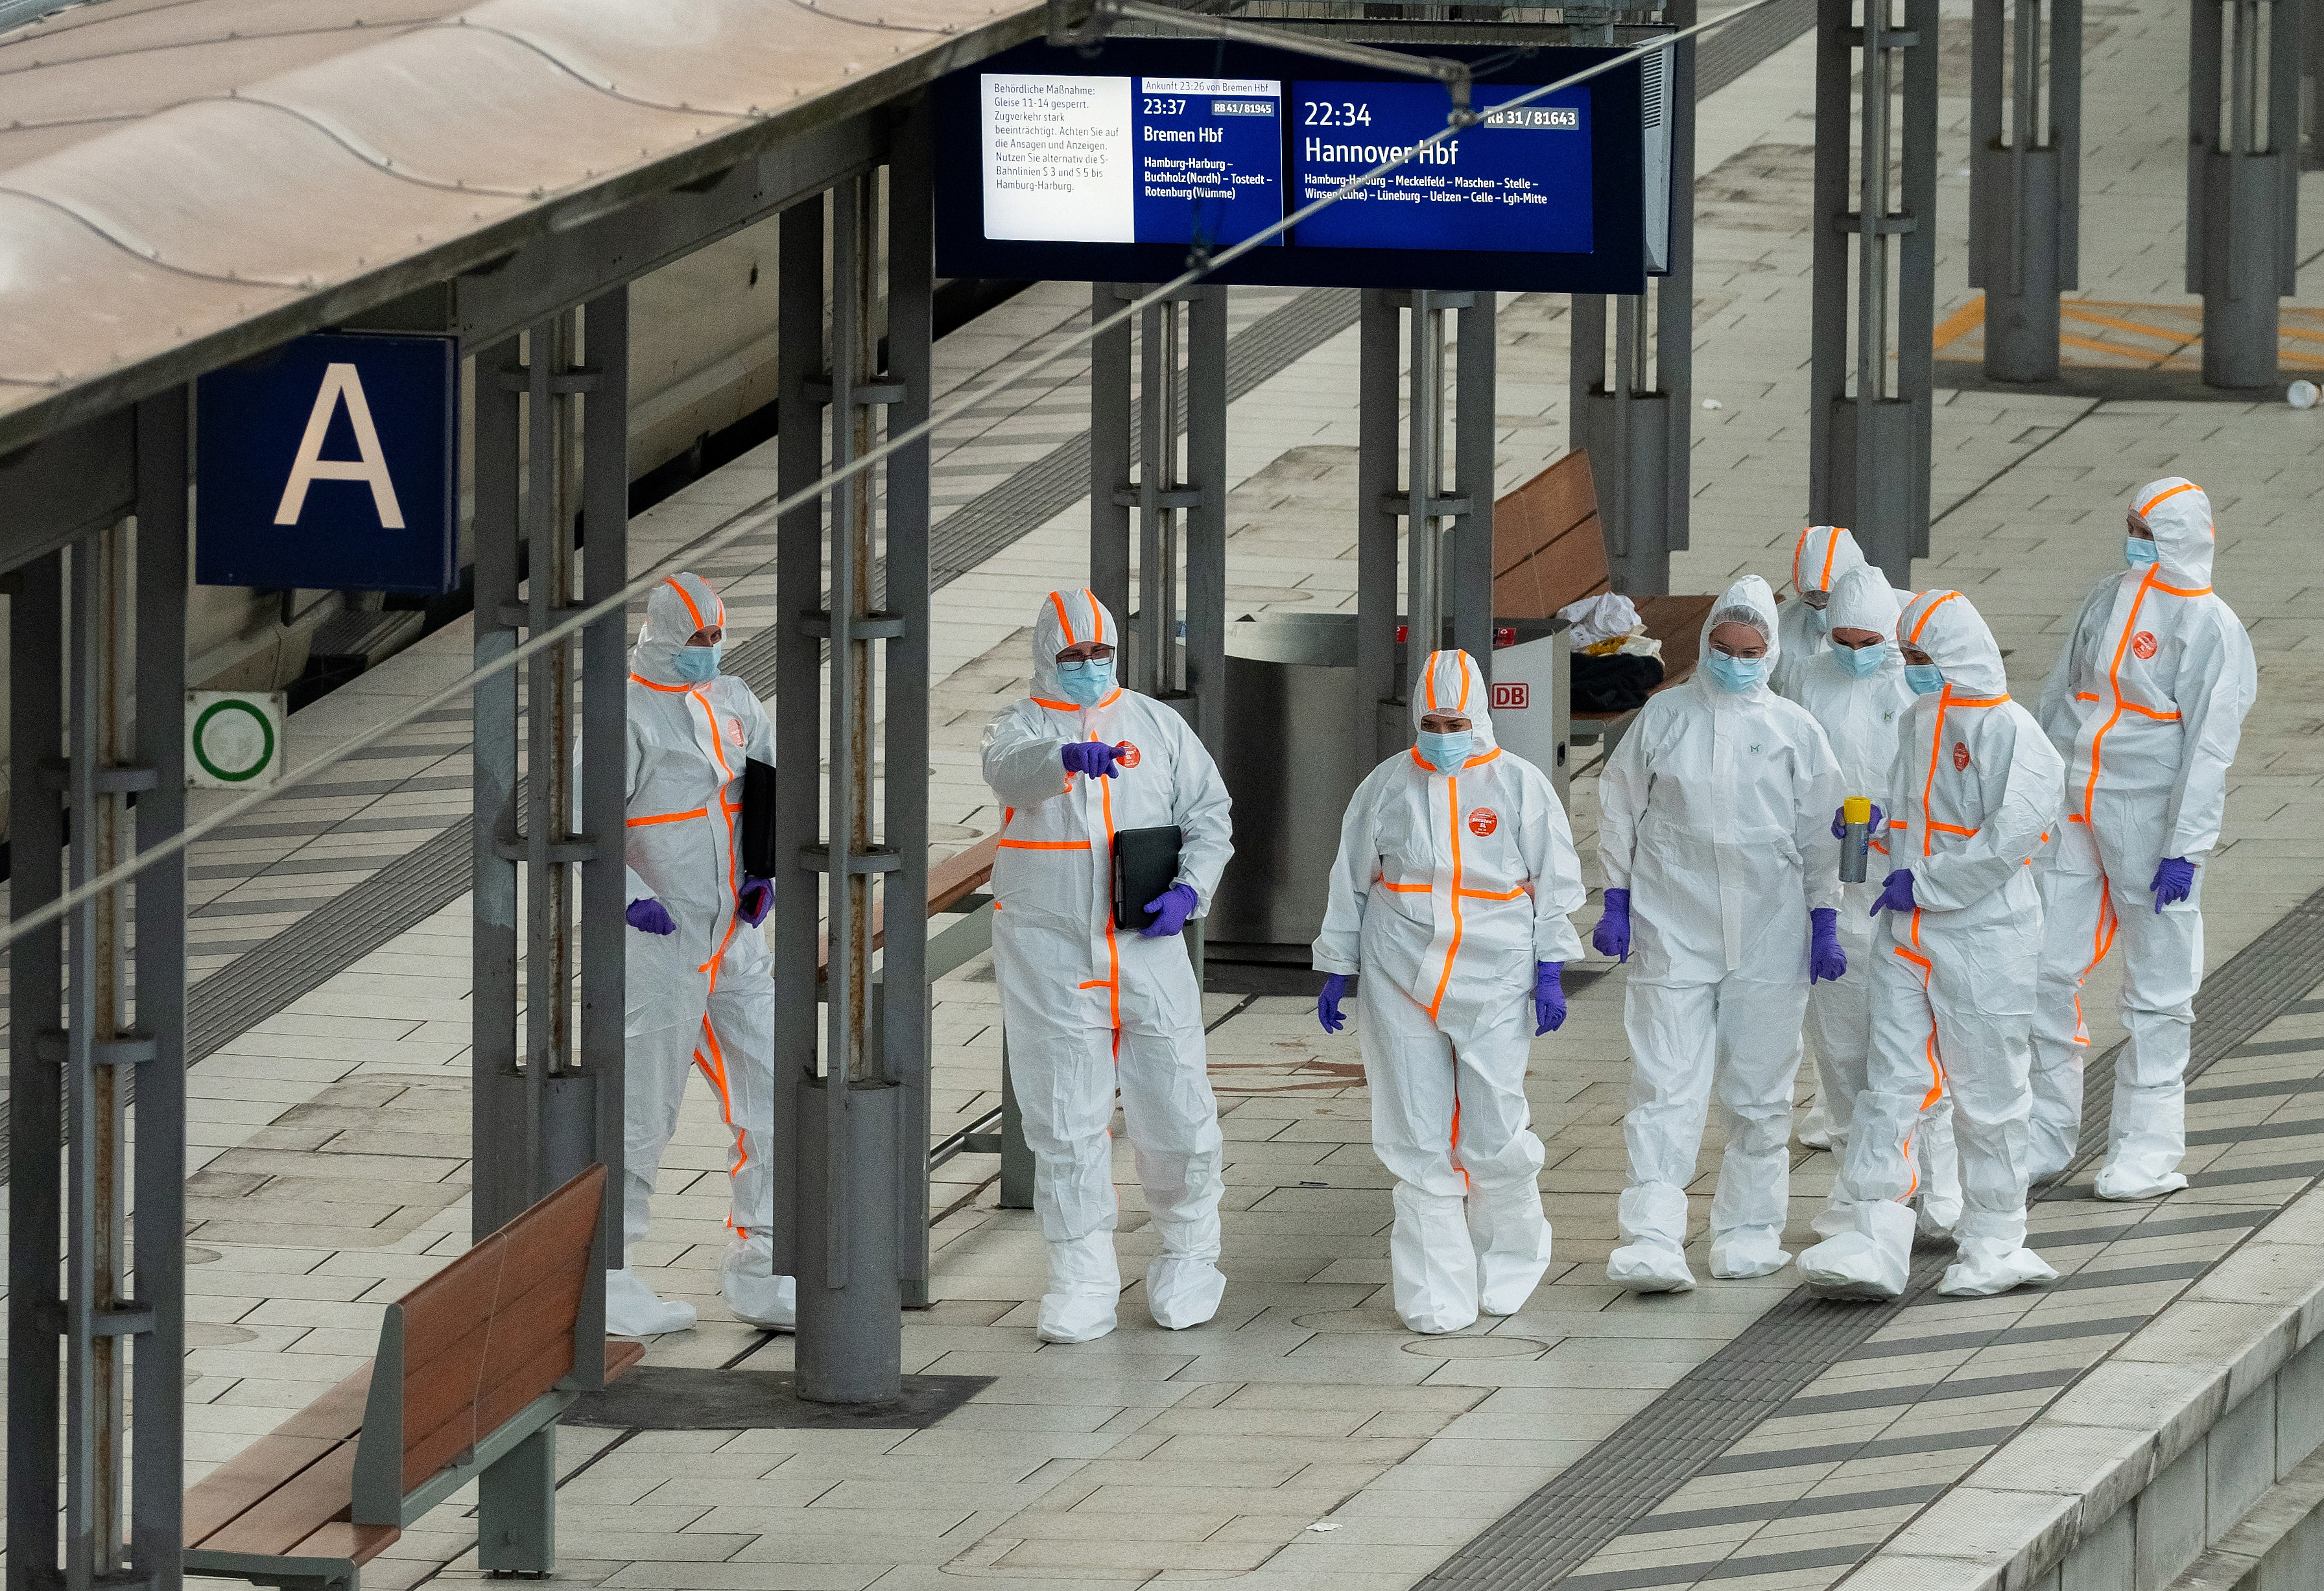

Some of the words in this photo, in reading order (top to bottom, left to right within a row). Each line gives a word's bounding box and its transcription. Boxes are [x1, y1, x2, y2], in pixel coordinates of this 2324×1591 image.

[994, 83, 1044, 94] Behördliche
[1047, 84, 1095, 95] Maßnahme:
[1146, 81, 1178, 90] Ankunft
[1180, 82, 1204, 91] 23:26
[1222, 82, 1252, 92] Bremen
[1254, 83, 1269, 92] Hbf
[995, 97, 1020, 107] Gleise
[1023, 98, 1049, 108] 11-14
[1051, 100, 1089, 110] gesperrt.
[1143, 99, 1186, 115] 23:37
[995, 111, 1041, 123] Zugverkehr
[1043, 113, 1065, 122] stark
[1305, 102, 1371, 126] 22:34
[1488, 111, 1504, 124] RB
[995, 124, 1056, 137] beeinträchtigt.
[1060, 126, 1088, 136] Achten
[1091, 127, 1103, 137] Sie
[1105, 127, 1119, 137] auf
[1144, 126, 1195, 142] Bremen
[1199, 127, 1224, 143] Hbf
[995, 139, 1008, 148] die
[1010, 139, 1046, 151] Ansagen
[1048, 141, 1064, 149] und
[1067, 141, 1108, 152] Anzeigen.
[1305, 137, 1413, 163] Hannover
[1419, 139, 1459, 165] Hbf
[996, 152, 1026, 162] Nutzen
[1028, 153, 1040, 162] Sie
[1043, 154, 1084, 163] alternativ
[1085, 154, 1098, 163] die
[1100, 154, 1108, 164] S-
[1144, 156, 1226, 172] Hamburg-Harburg
[997, 166, 1041, 176] Bahnlinien
[1043, 167, 1048, 176] S
[1050, 167, 1056, 176] 3
[1058, 168, 1074, 177] und
[1076, 168, 1081, 177] S
[1084, 168, 1089, 178] 5
[1091, 168, 1103, 178] bis
[1231, 173, 1264, 185] Tostedt
[1395, 176, 1445, 187] Meckelfeld
[1454, 176, 1495, 188] Maschen
[1504, 178, 1530, 189] Stelle
[997, 180, 1074, 193] Hamburg-Harburg.
[1377, 189, 1420, 204] Lüneburg
[1430, 191, 1462, 202] Uelzen
[1471, 191, 1493, 203] Celle
[1503, 192, 1548, 206] Lgh-Mitte
[274, 362, 406, 529] A
[1496, 687, 1524, 705] DB
